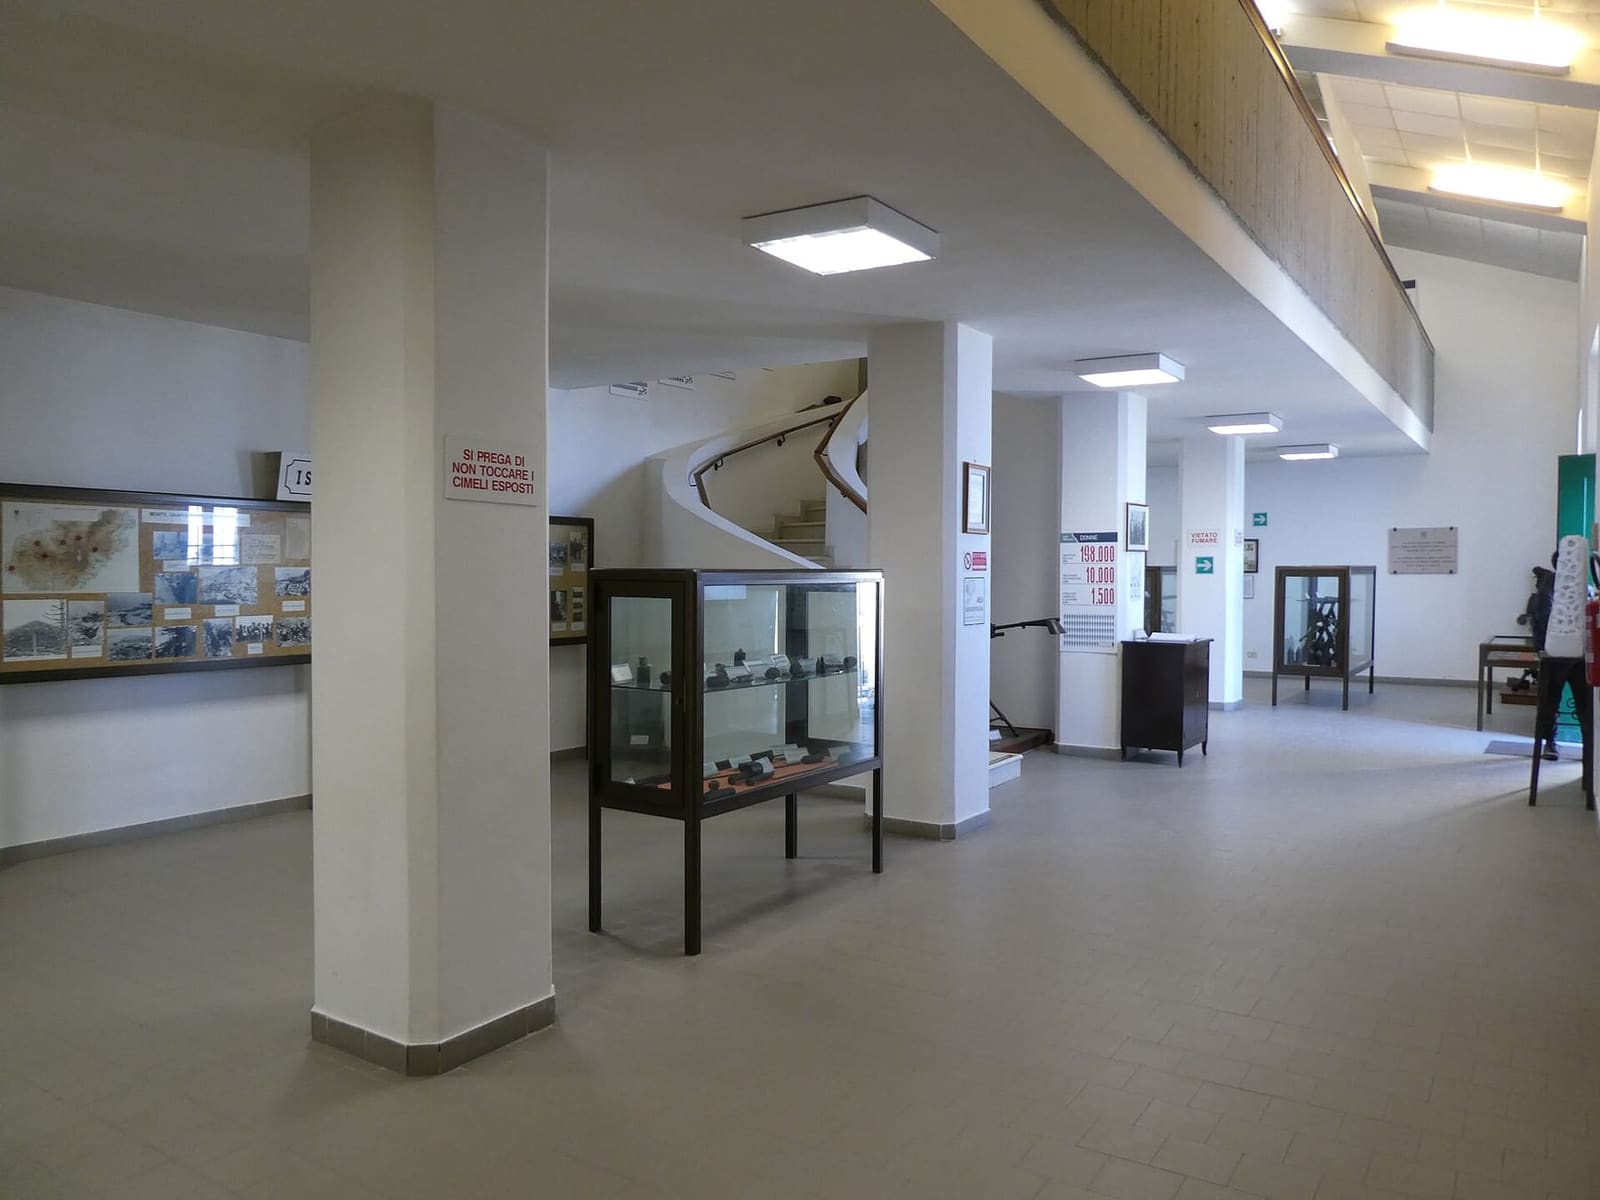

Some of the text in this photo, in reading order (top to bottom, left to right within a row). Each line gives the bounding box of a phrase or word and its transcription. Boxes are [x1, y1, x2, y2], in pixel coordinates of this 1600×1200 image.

[463, 449, 525, 467] SI PREGA DI
[452, 462, 534, 481] NON TOCCARE I
[453, 476, 533, 494] CIMELI ESPOSTI
[1080, 545, 1114, 562] 198.000
[1086, 567, 1114, 583] 10.000
[1091, 587, 1114, 604] 1.500
